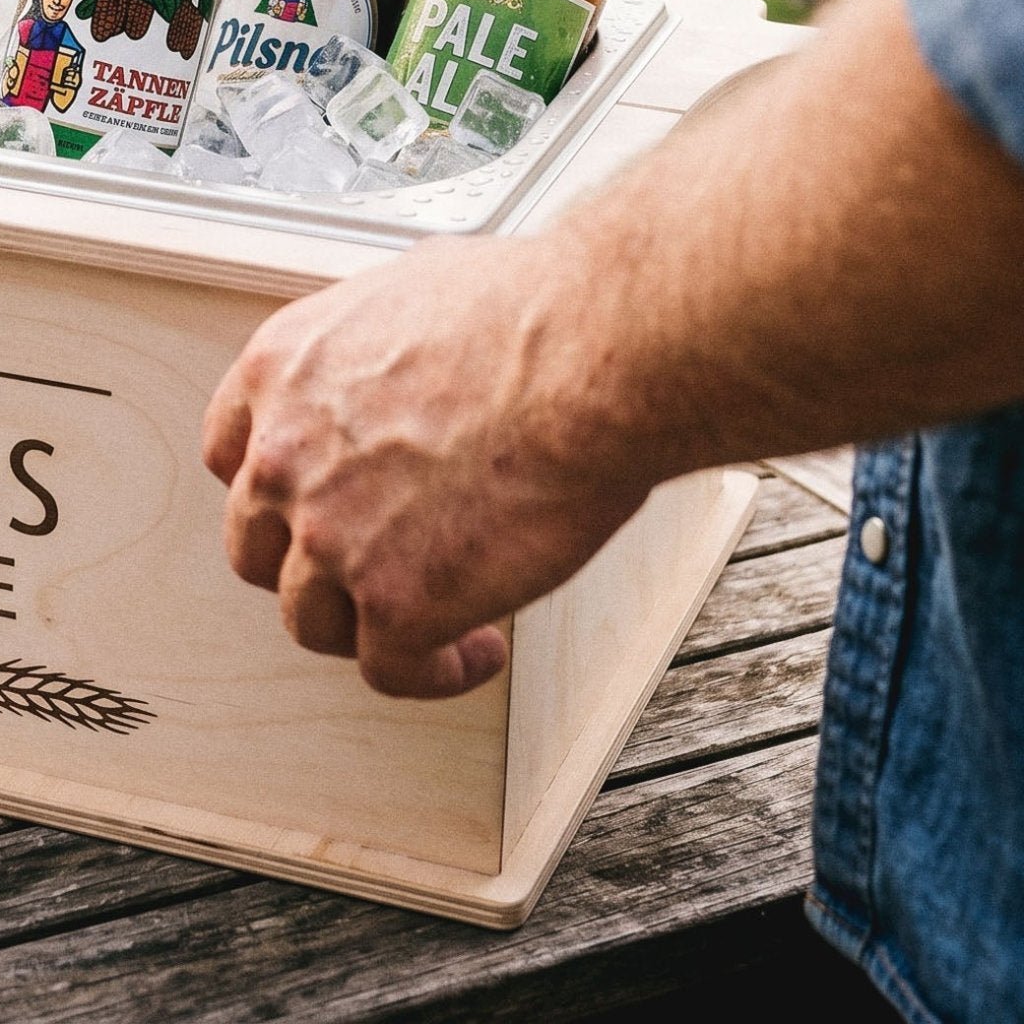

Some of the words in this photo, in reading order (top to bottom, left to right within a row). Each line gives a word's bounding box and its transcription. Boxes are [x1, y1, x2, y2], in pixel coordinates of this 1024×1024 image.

[206, 17, 334, 77] Pilsn
[93, 60, 191, 99] TANNEN
[404, 52, 460, 115] AL
[88, 86, 182, 124] ZÄPFLE
